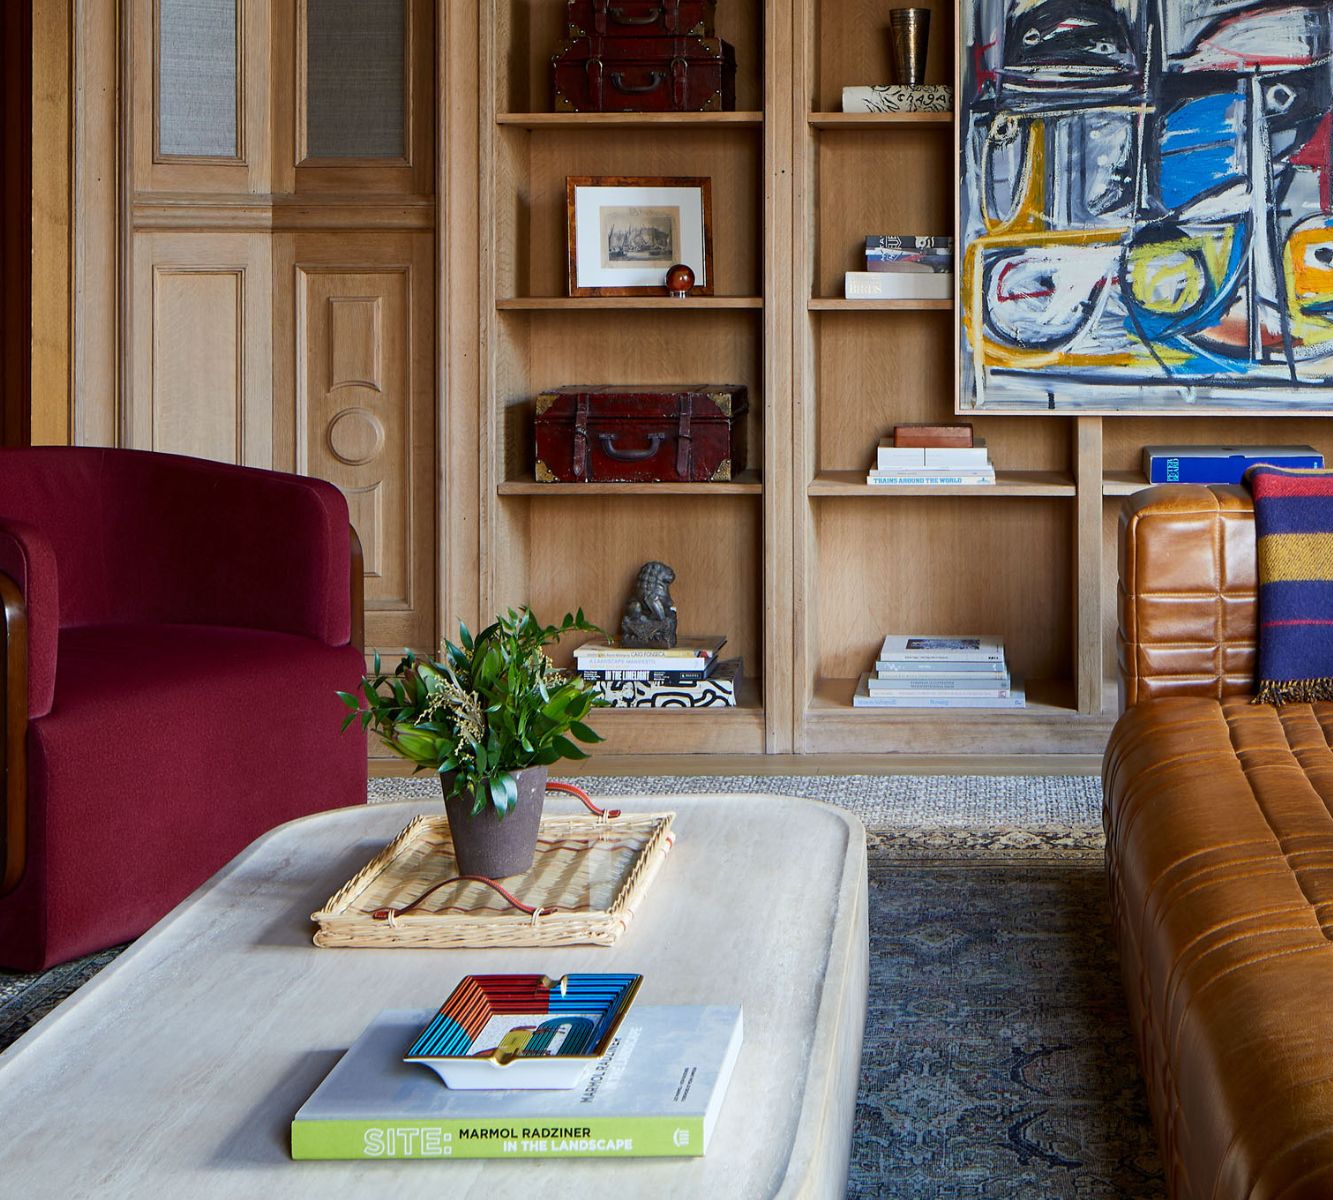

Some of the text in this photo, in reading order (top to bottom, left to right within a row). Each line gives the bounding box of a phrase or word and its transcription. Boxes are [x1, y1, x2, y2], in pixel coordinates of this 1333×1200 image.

[605, 670, 612, 681] IN
[612, 670, 622, 681] THE
[623, 670, 650, 681] LIMELIGHT
[459, 1127, 591, 1139] MARMOL RADZINER
[364, 1127, 452, 1156] SITE:
[503, 1139, 633, 1152] IN THE LANDSCAPE
